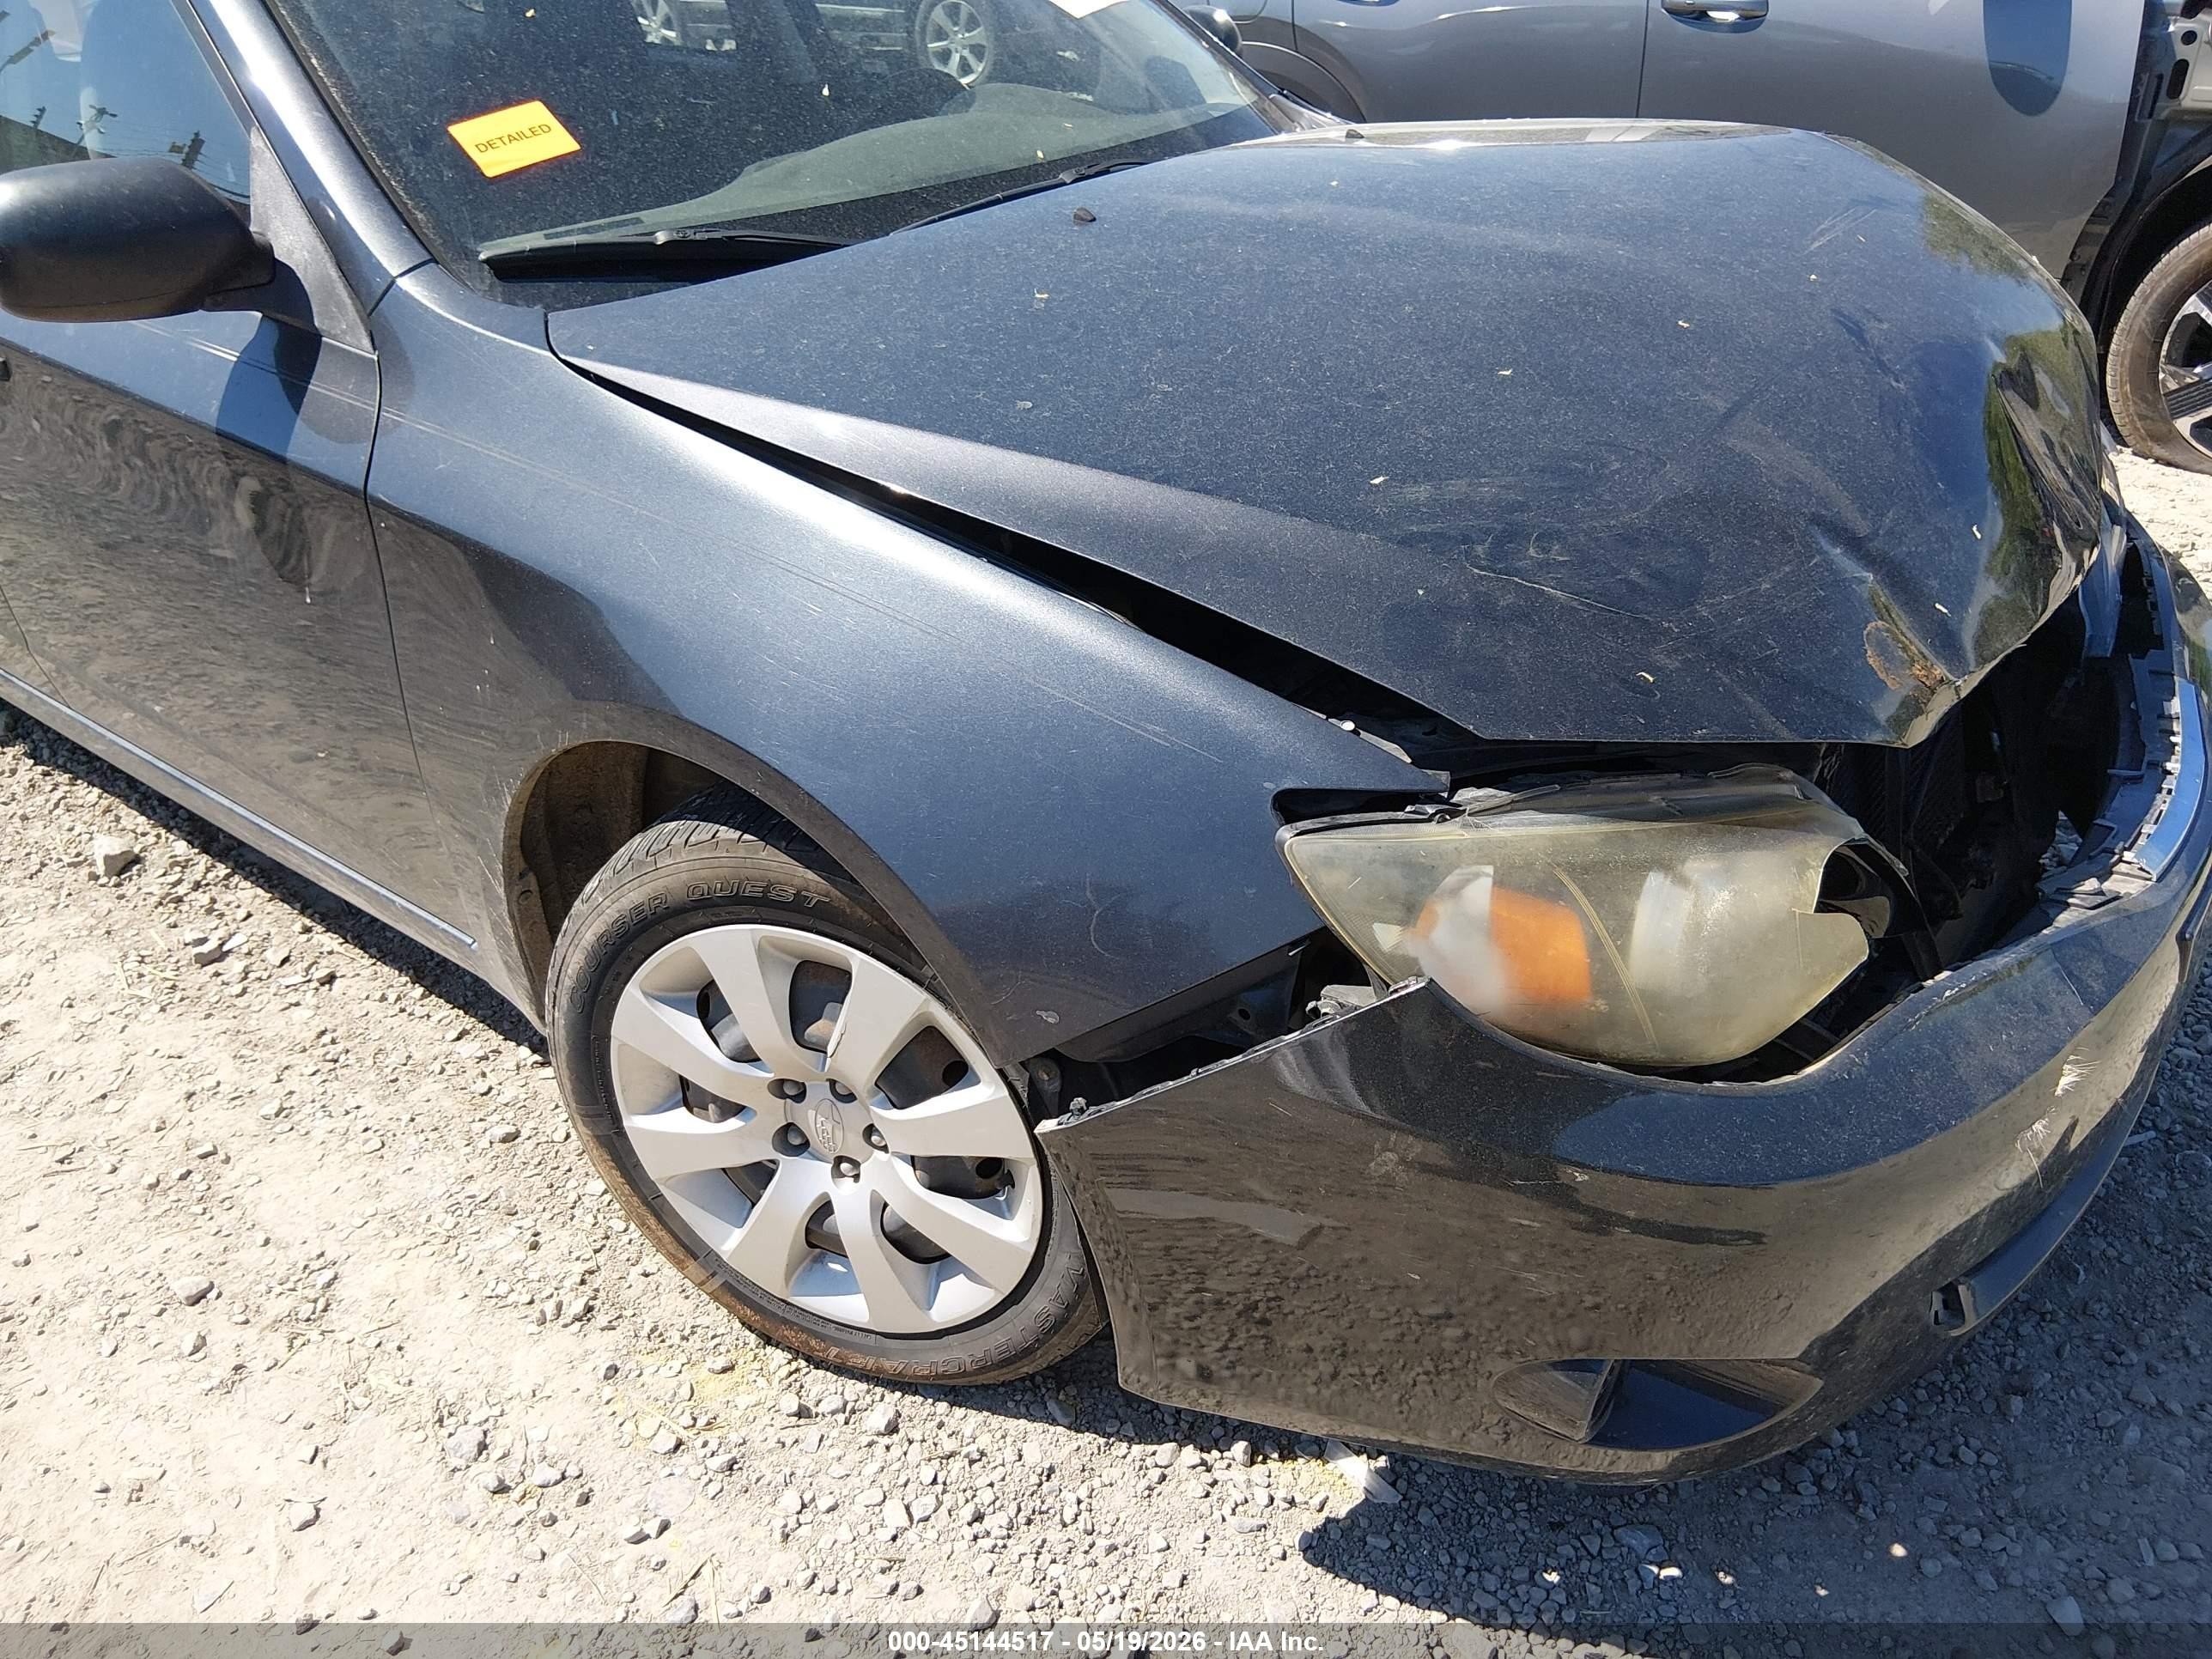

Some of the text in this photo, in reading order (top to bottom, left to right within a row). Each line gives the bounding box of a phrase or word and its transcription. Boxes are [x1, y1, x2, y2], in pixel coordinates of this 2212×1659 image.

[474, 124, 552, 153] DETAILED
[569, 879, 830, 1013] COURSER QUEST
